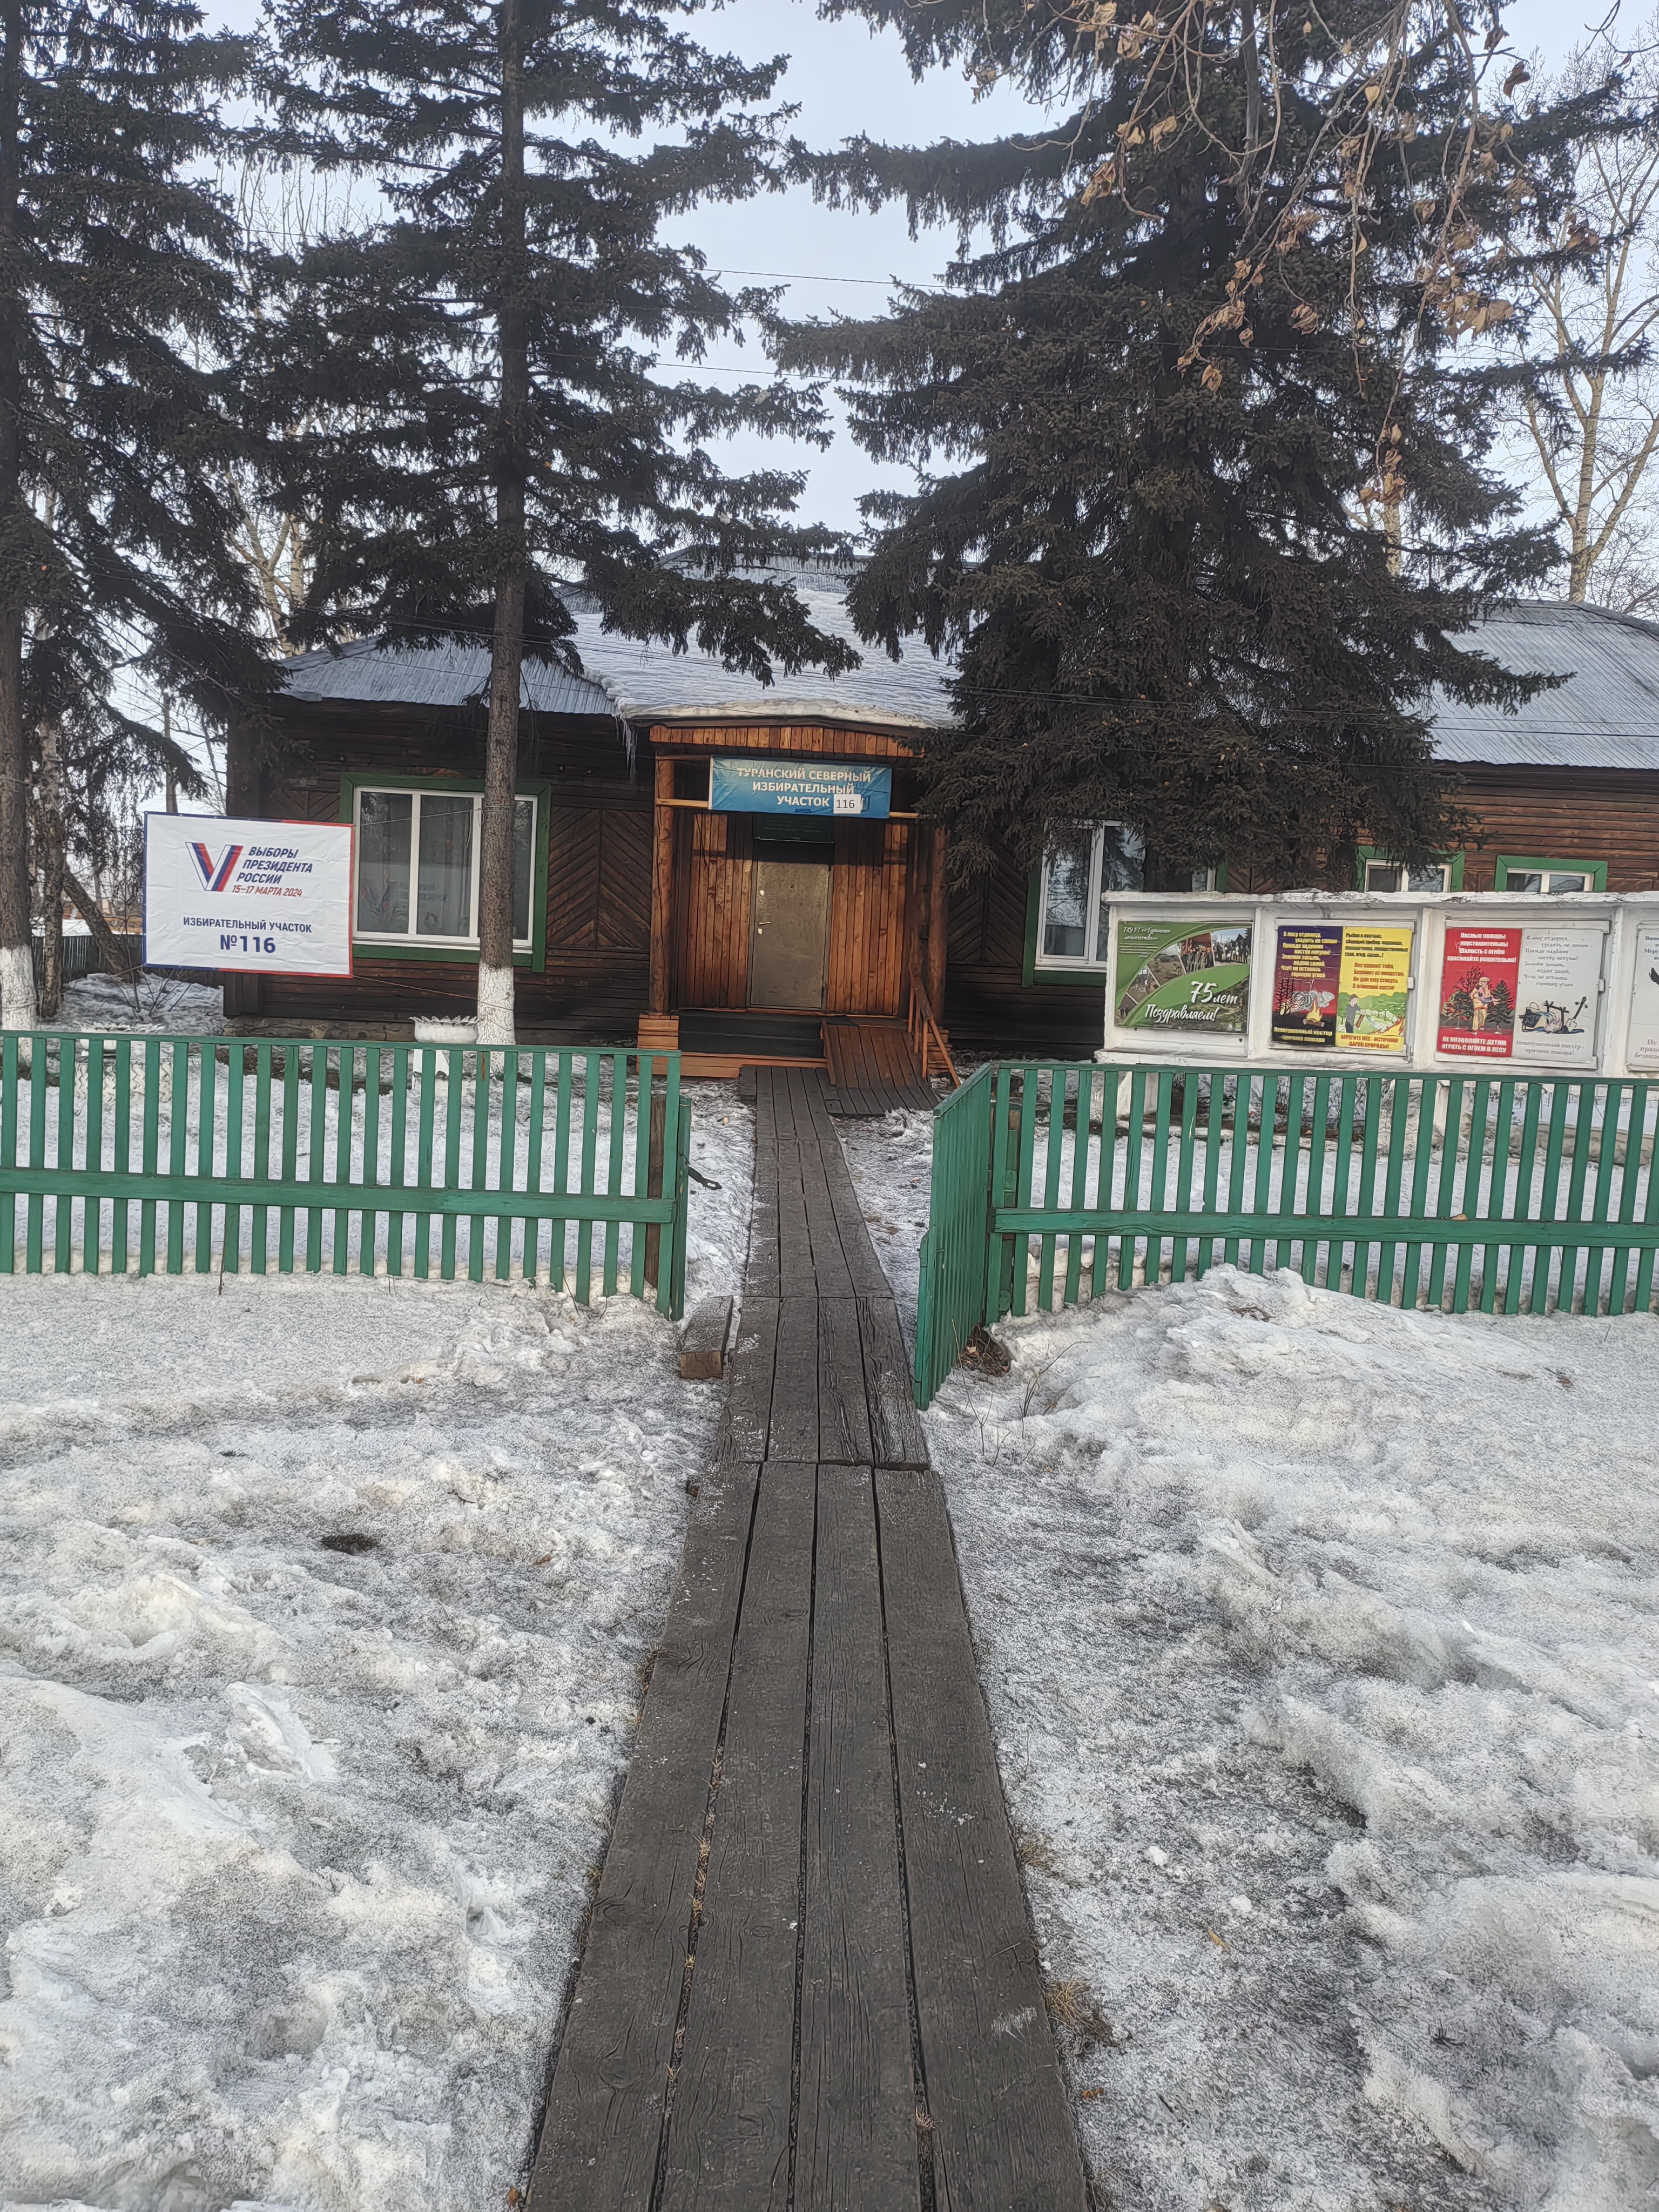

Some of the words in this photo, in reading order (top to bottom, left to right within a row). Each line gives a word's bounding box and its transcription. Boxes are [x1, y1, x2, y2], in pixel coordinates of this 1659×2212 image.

[737, 767, 805, 779] ТУРАНСКИЙ
[809, 770, 871, 783] СЕВЕРНЫЙ
[753, 781, 854, 794] ИЗБИРАТЕЛЬНЫЙ
[777, 795, 830, 807] УЧАСТОК
[836, 799, 855, 808] 116
[248, 846, 299, 859] ВЫБОРЫ
[242, 859, 313, 873] ПРЕЗИДЕНТА
[236, 873, 282, 884] РОССИИ
[254, 886, 282, 895] МАРТА
[282, 888, 302, 897] 2024
[183, 916, 266, 930] ИЗБИРАТЕЛЬНЫЙ
[269, 922, 312, 933] УЧАСТОК
[1190, 981, 1217, 1003] 75
[1213, 994, 1238, 1004] лет
[1145, 1004, 1220, 1023] Поздравляем!
